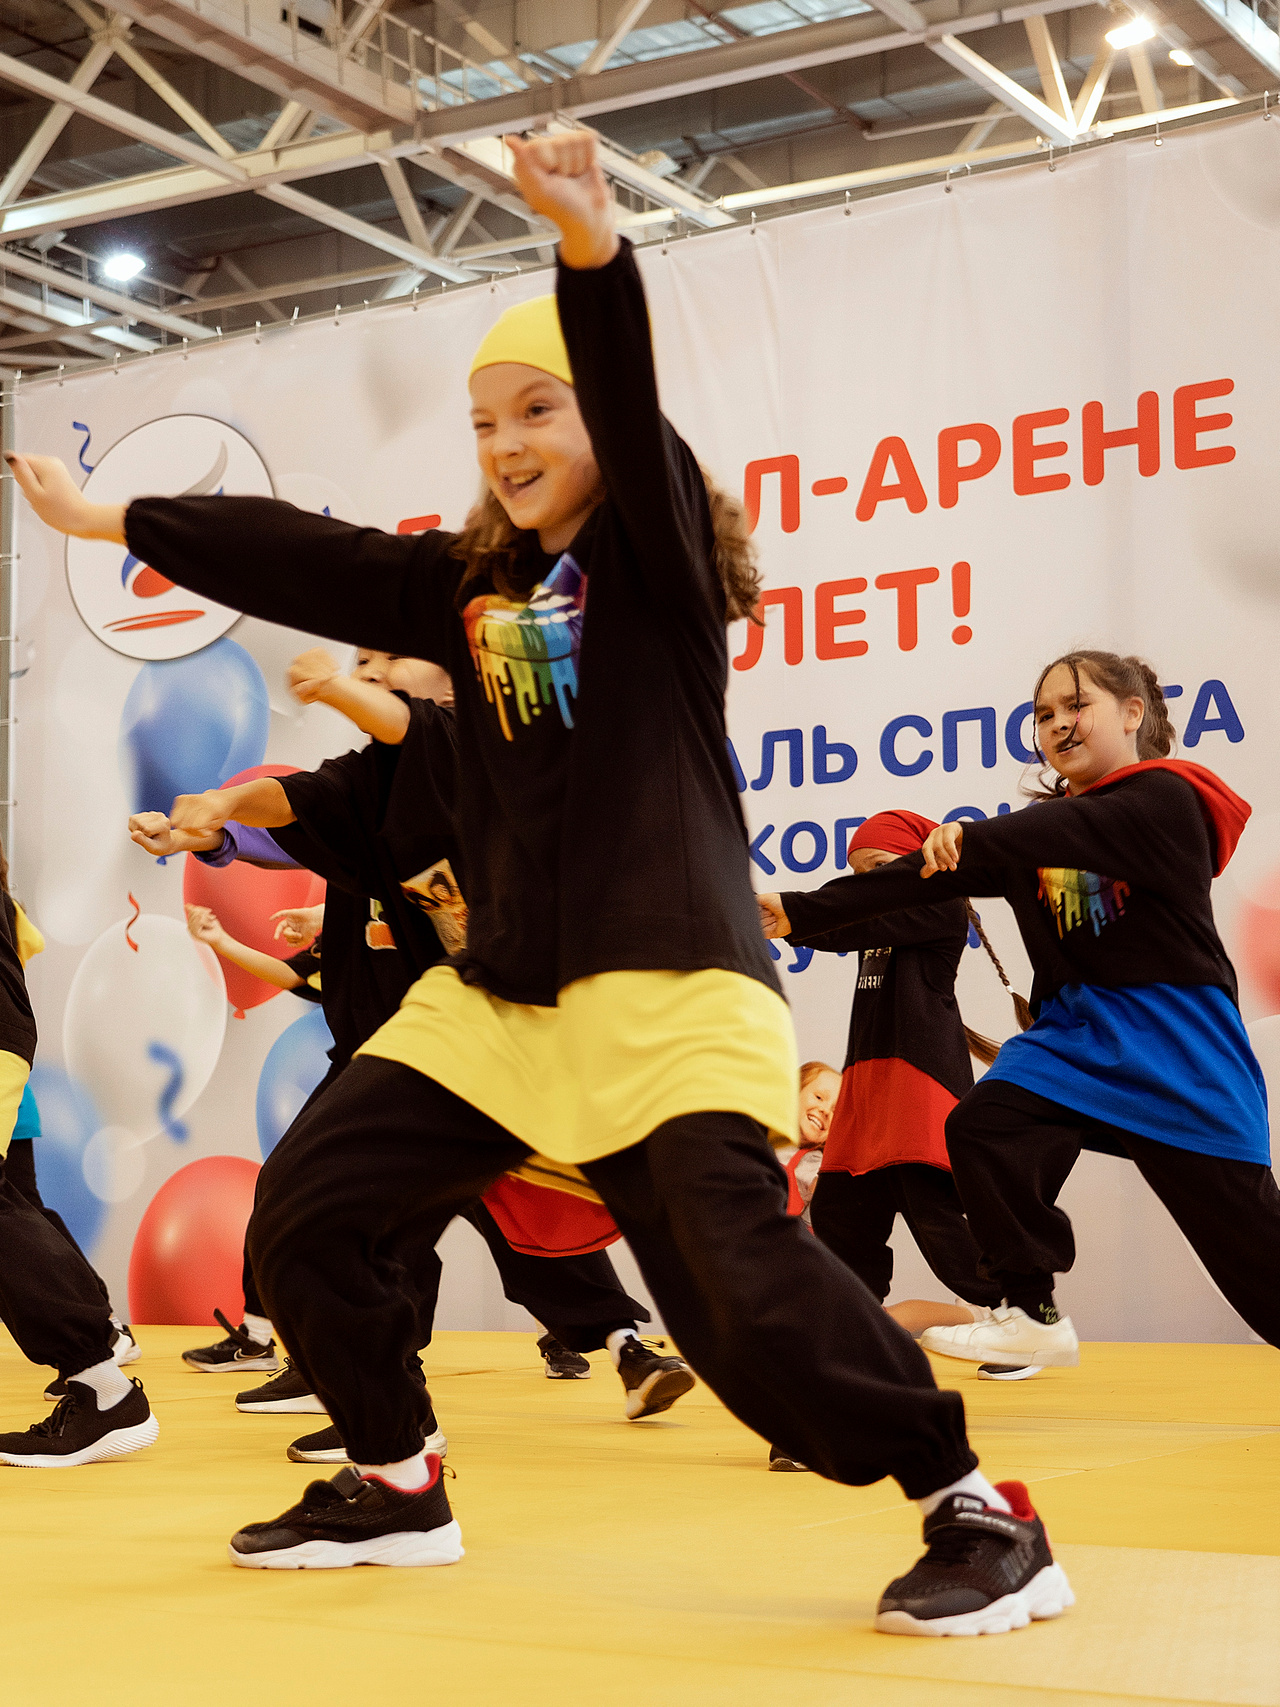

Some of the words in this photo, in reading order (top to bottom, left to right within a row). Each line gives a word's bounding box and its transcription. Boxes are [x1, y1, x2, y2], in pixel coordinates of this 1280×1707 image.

[743, 378, 1237, 535] Л-АРЕНЕ
[732, 561, 973, 672] ЛЕТ!
[879, 679, 1245, 777] СПОА
